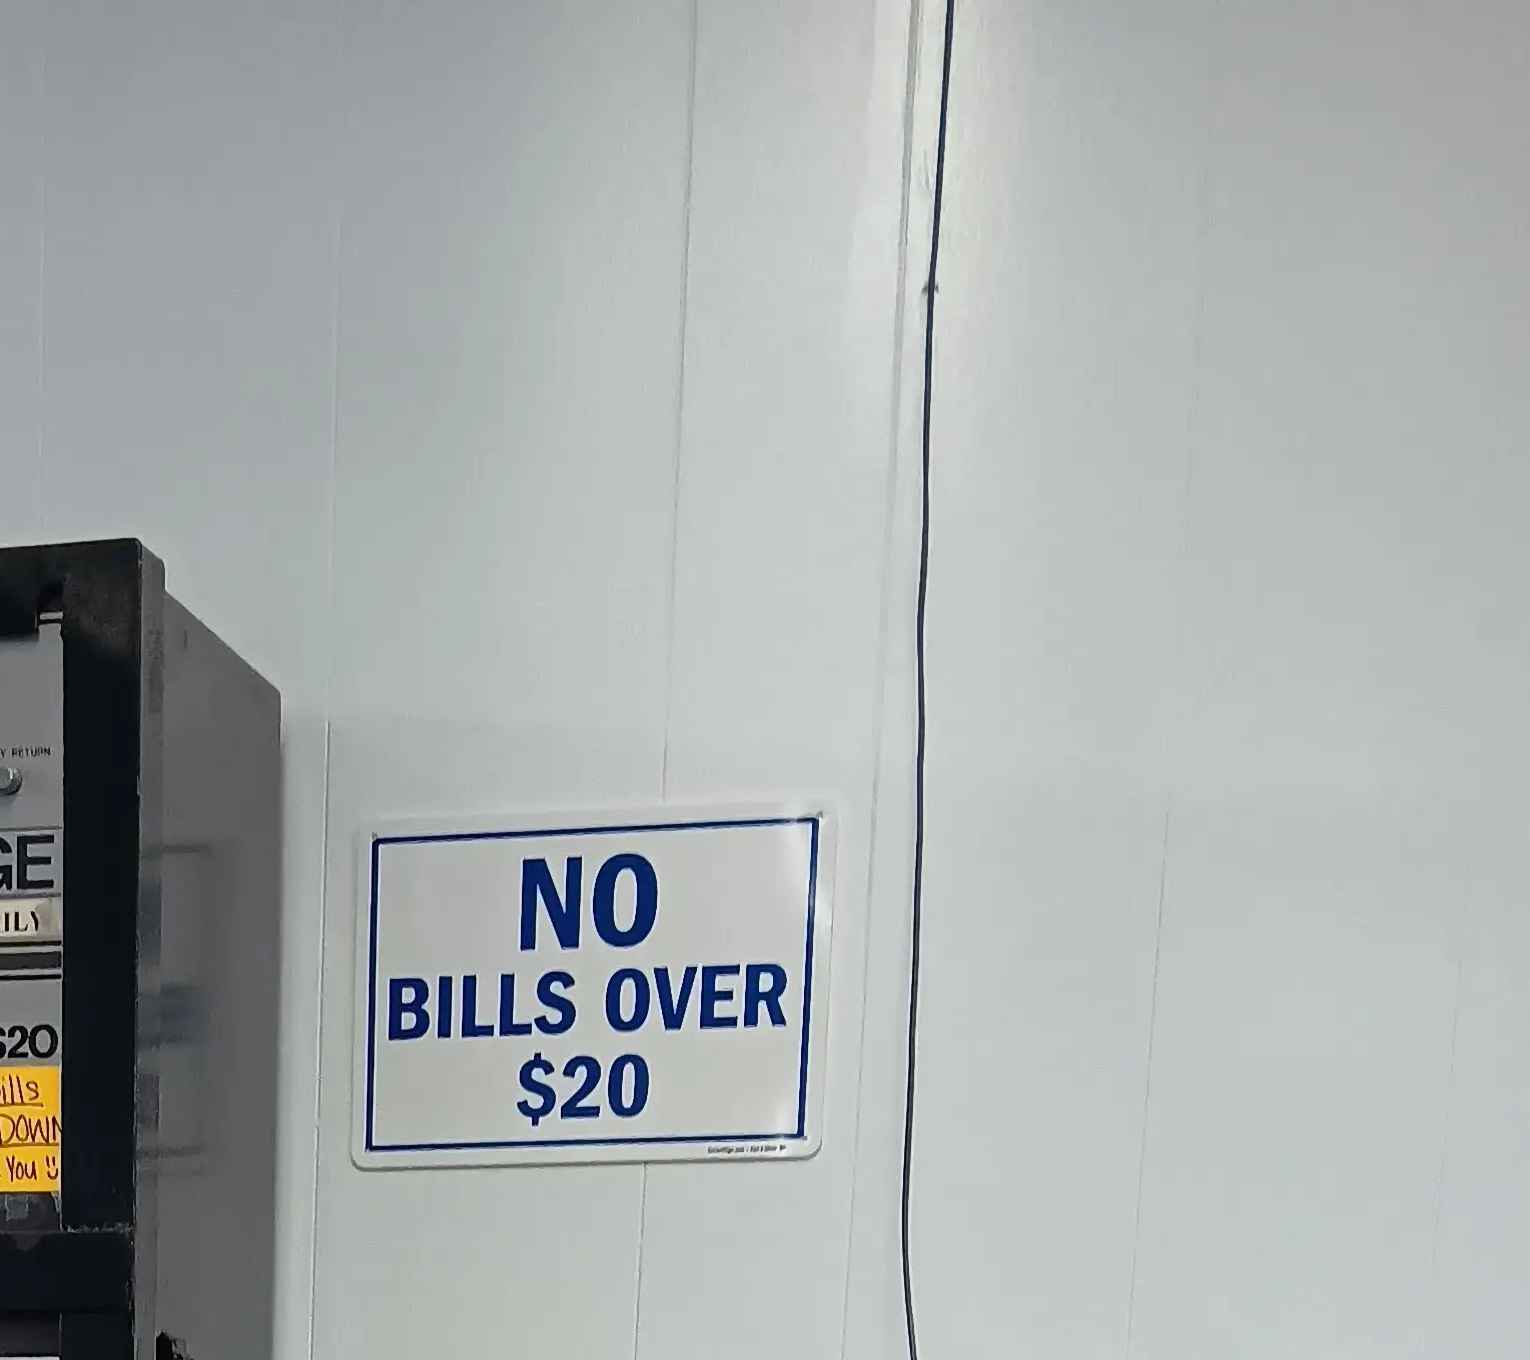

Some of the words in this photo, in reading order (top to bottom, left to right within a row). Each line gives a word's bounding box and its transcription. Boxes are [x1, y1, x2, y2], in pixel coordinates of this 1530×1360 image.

[520, 853, 659, 951] NO
[387, 970, 577, 1042] BILLS
[605, 963, 788, 1032] OVER
[517, 1052, 650, 1127] $20
[5, 1154, 38, 1183] You
